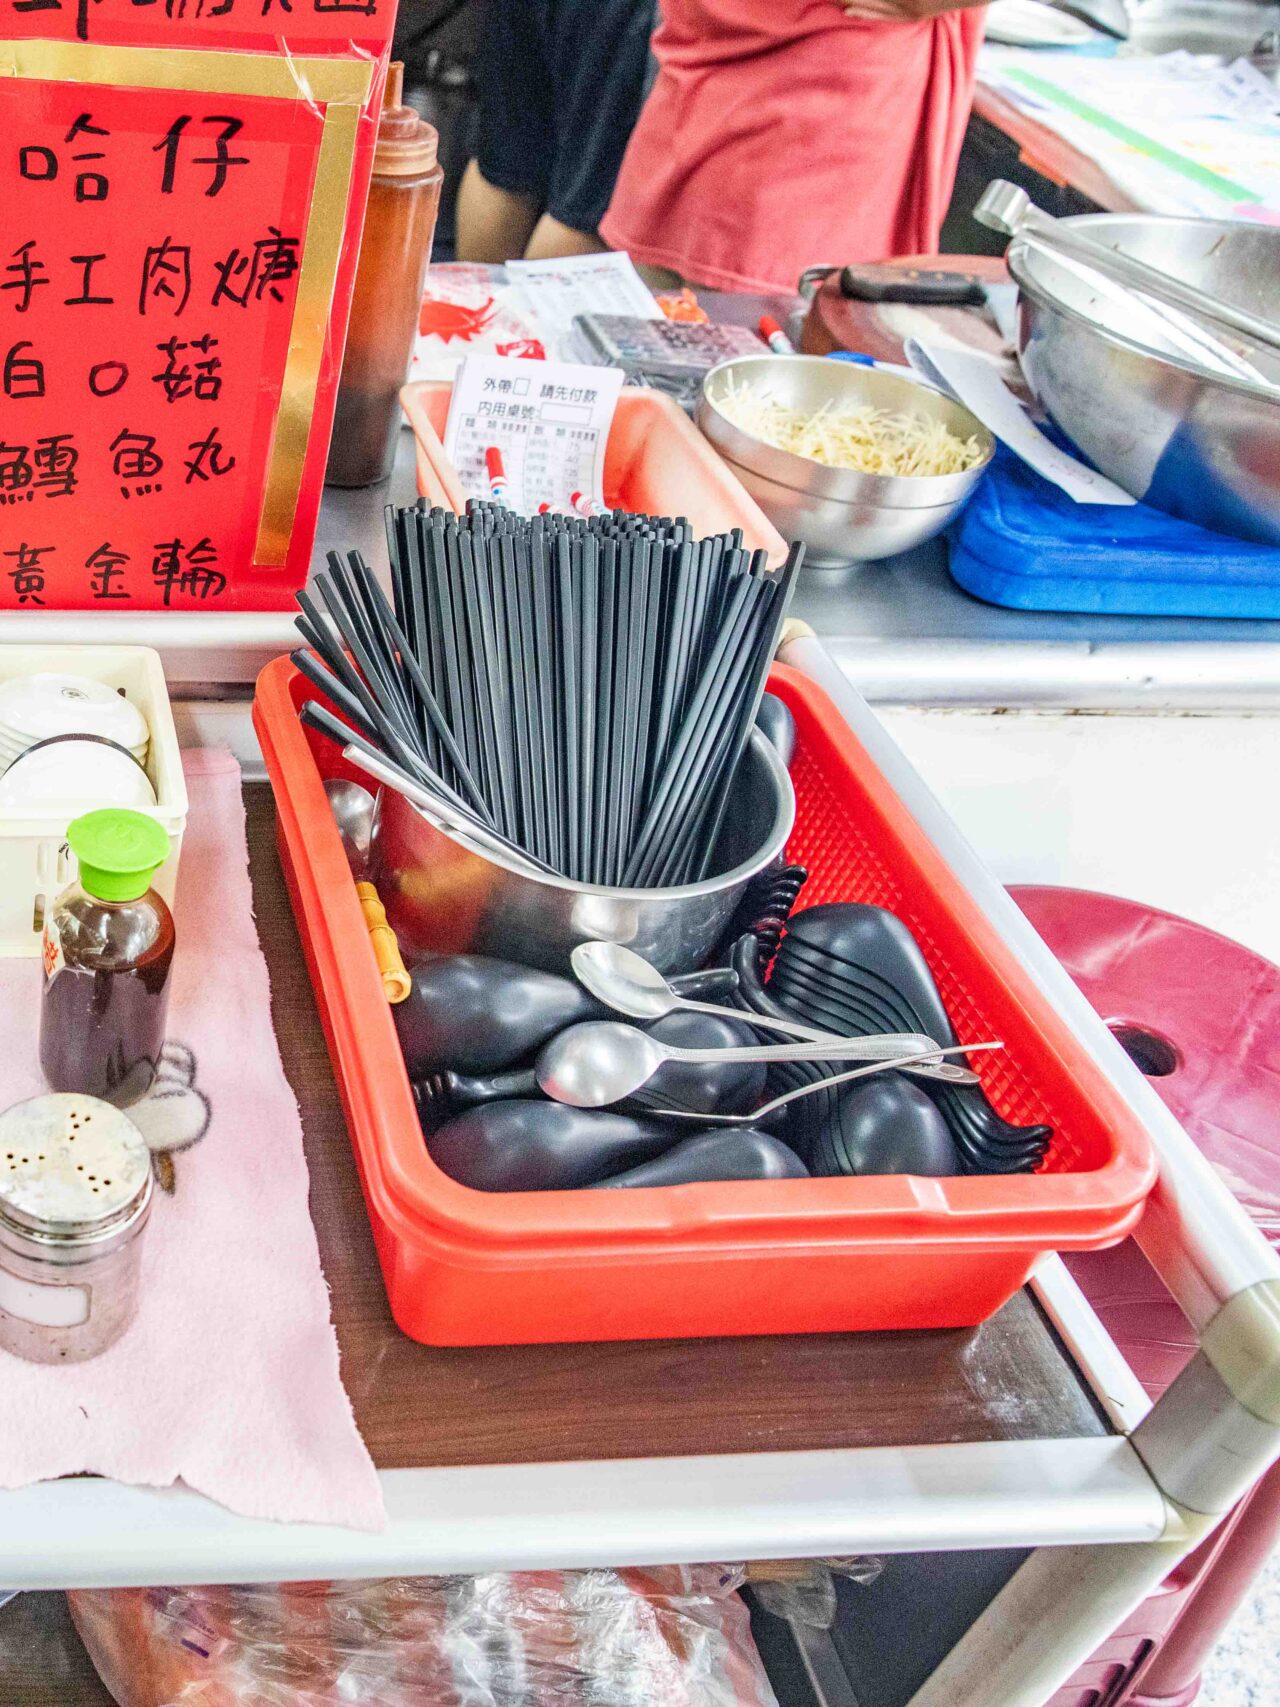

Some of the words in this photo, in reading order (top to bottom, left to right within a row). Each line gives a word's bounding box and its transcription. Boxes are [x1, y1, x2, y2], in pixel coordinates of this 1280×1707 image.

[19, 113, 250, 203] 哈仔
[539, 383, 598, 403] 請先付款
